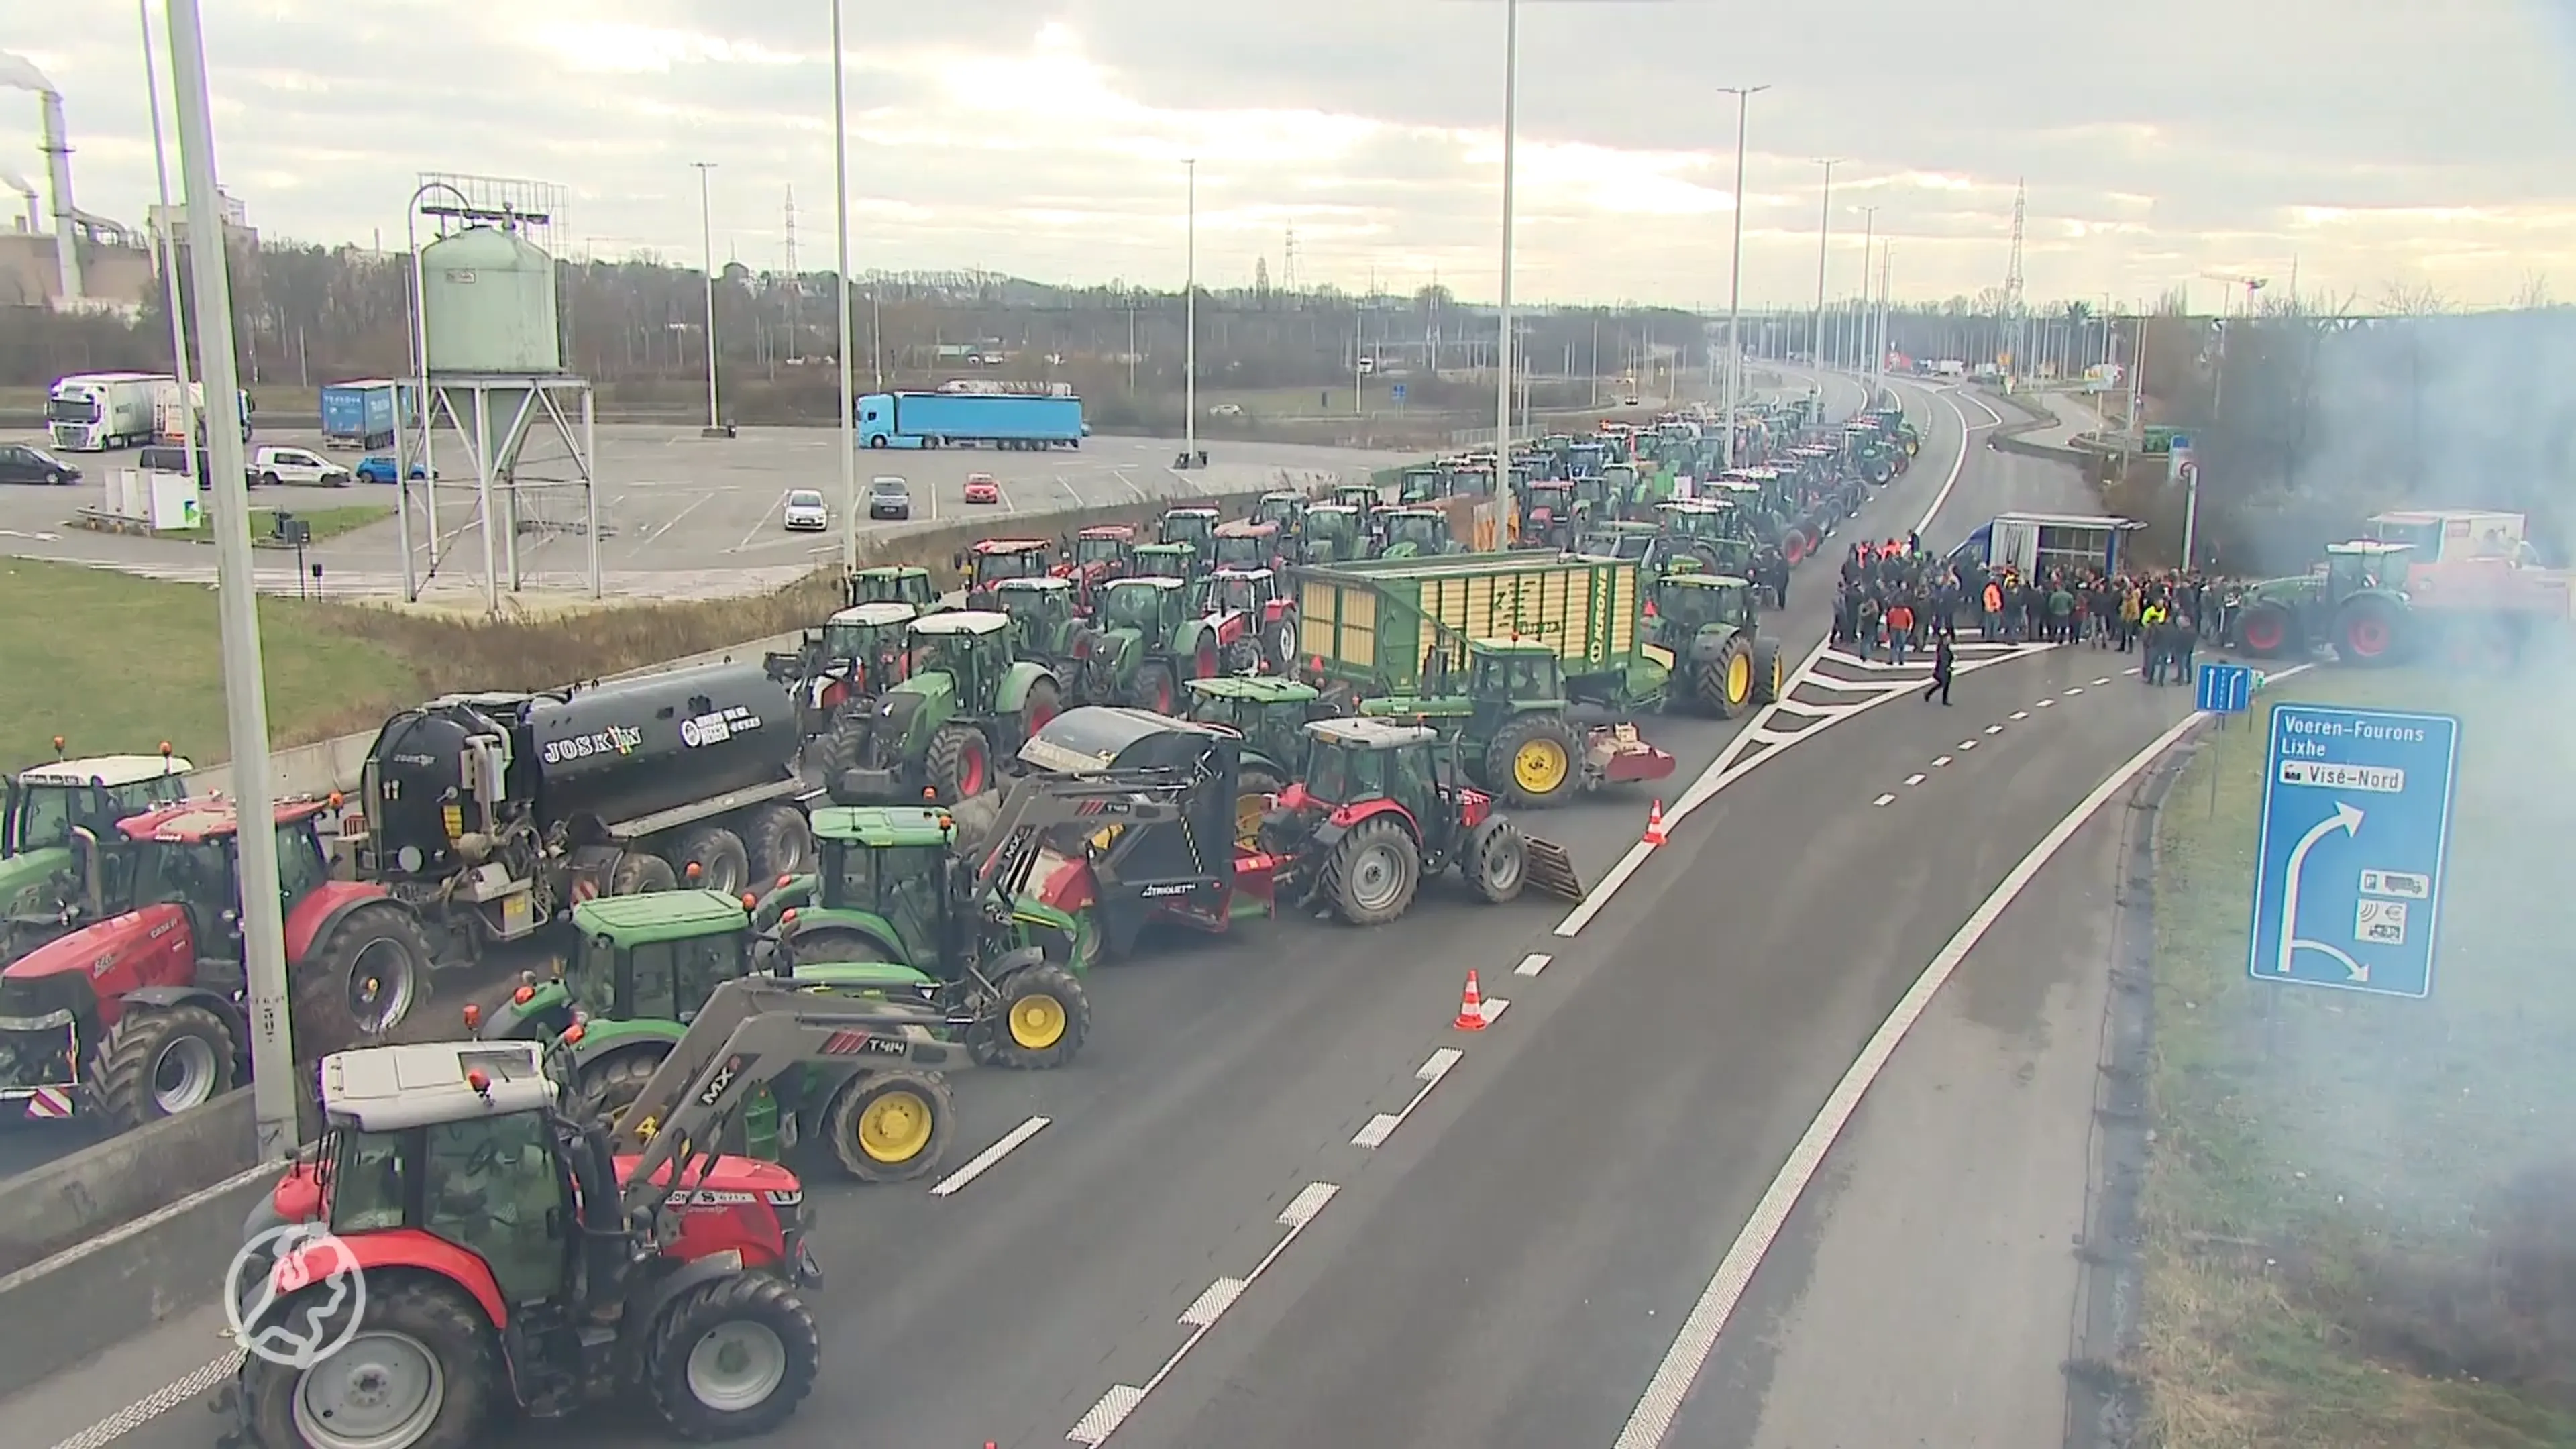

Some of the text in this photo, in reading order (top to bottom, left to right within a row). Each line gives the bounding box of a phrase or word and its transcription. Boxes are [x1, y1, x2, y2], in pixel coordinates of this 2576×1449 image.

[1593, 566, 1608, 642] KRONE
[2284, 715, 2424, 742] Voeren-Fourons
[544, 726, 641, 763] JOSKIN
[2282, 738, 2326, 757] Lixhe
[2309, 765, 2399, 789] Visé-Nord
[869, 1040, 904, 1055] T414
[701, 1066, 735, 1105] MX
